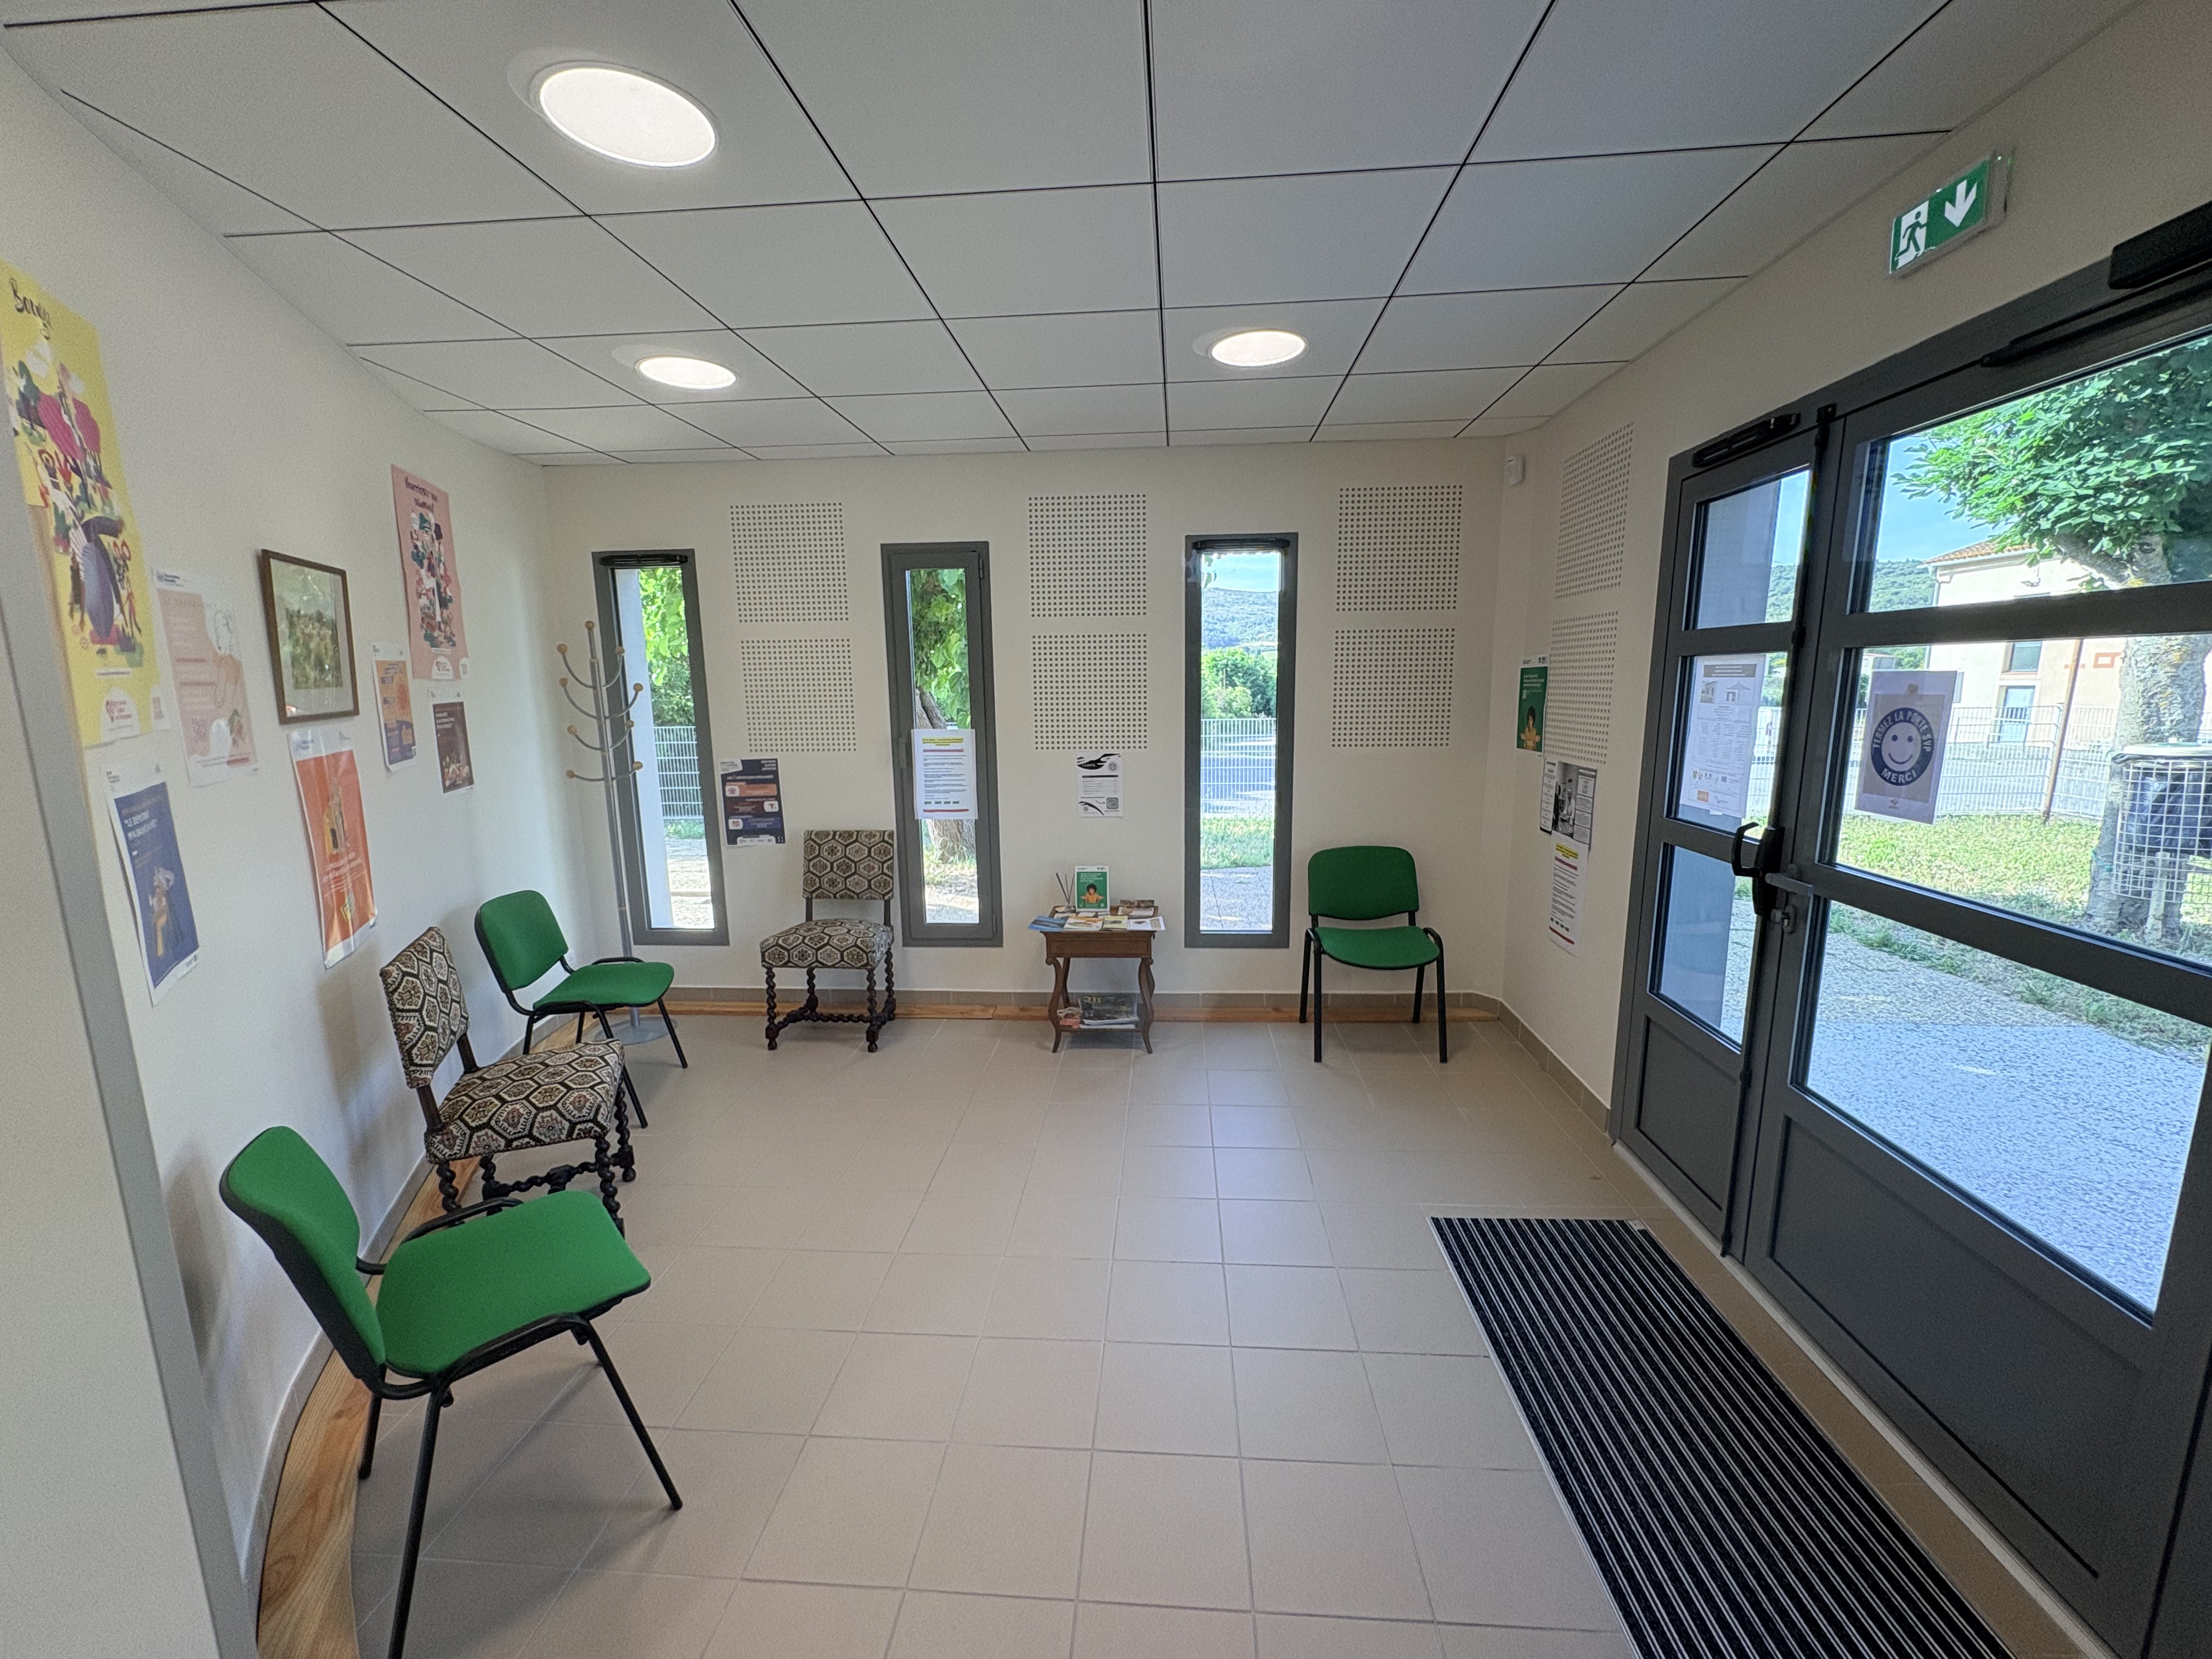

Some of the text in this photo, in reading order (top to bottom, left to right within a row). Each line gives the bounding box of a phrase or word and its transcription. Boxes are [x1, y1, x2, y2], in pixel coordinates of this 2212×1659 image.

[1872, 710, 1932, 752] FERMEZ LA PORTE SVP
[1881, 768, 1917, 783] MERCI
